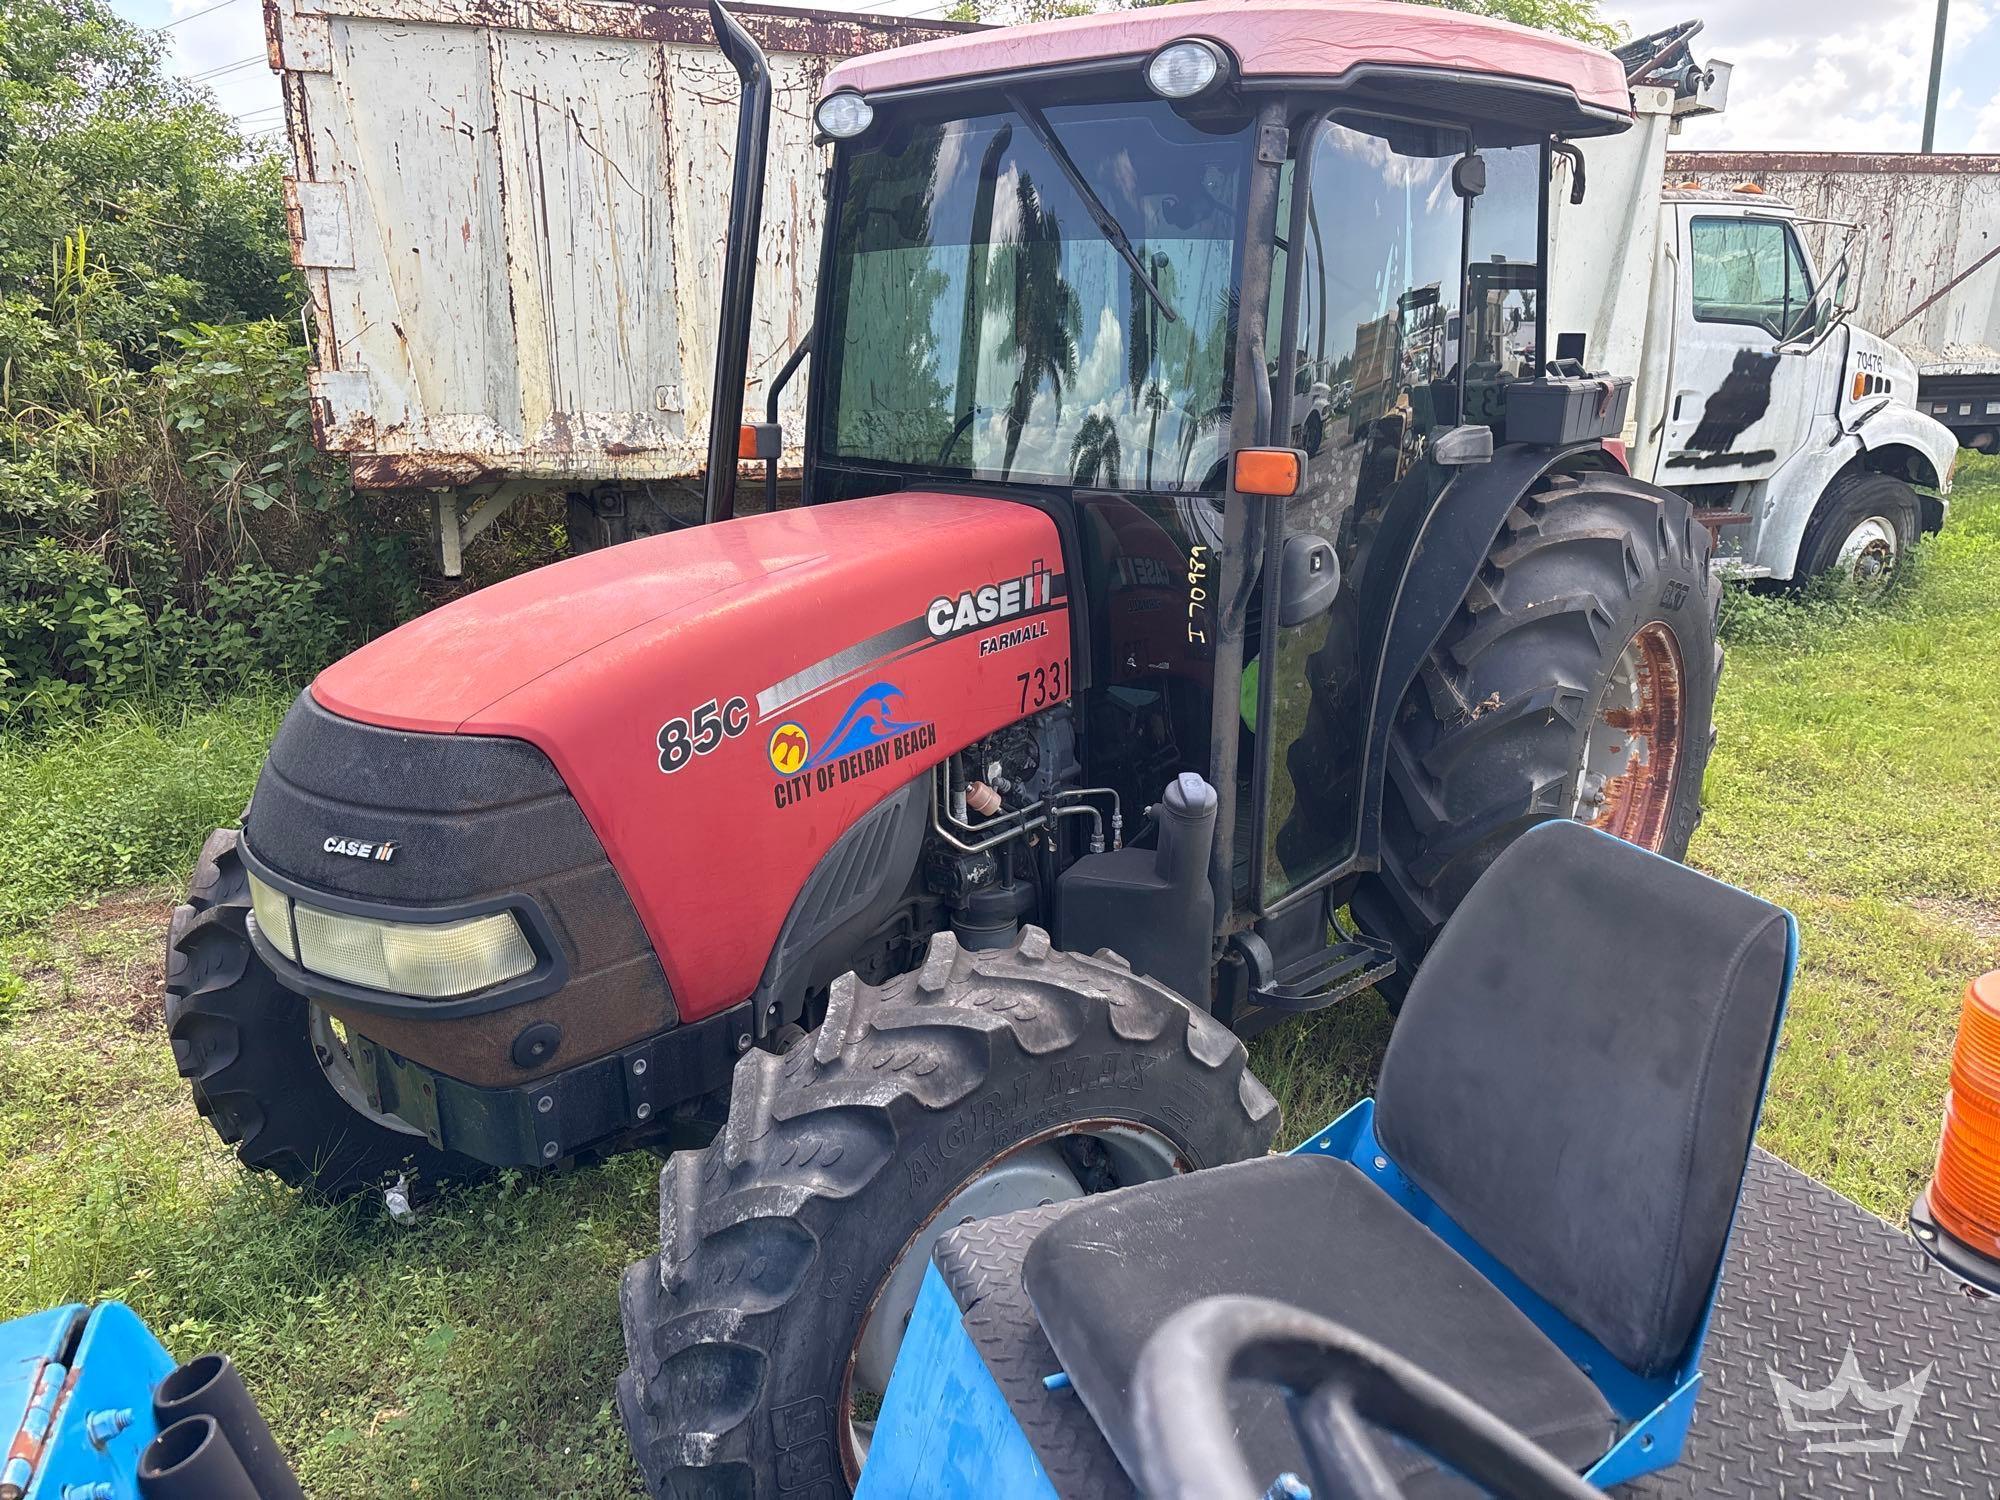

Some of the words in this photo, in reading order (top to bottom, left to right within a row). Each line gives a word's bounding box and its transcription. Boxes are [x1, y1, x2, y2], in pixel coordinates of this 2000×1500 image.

[1856, 351, 1883, 373] 70476
[927, 580, 1020, 636] CASE
[979, 621, 1048, 658] FARMALL
[1017, 657, 1070, 713] 7331
[657, 696, 749, 773] 85C
[774, 773, 811, 808] CITY
[816, 764, 835, 792] OF
[839, 741, 889, 784] DELRAY
[893, 723, 936, 761] BEACH
[323, 837, 373, 859] CASE
